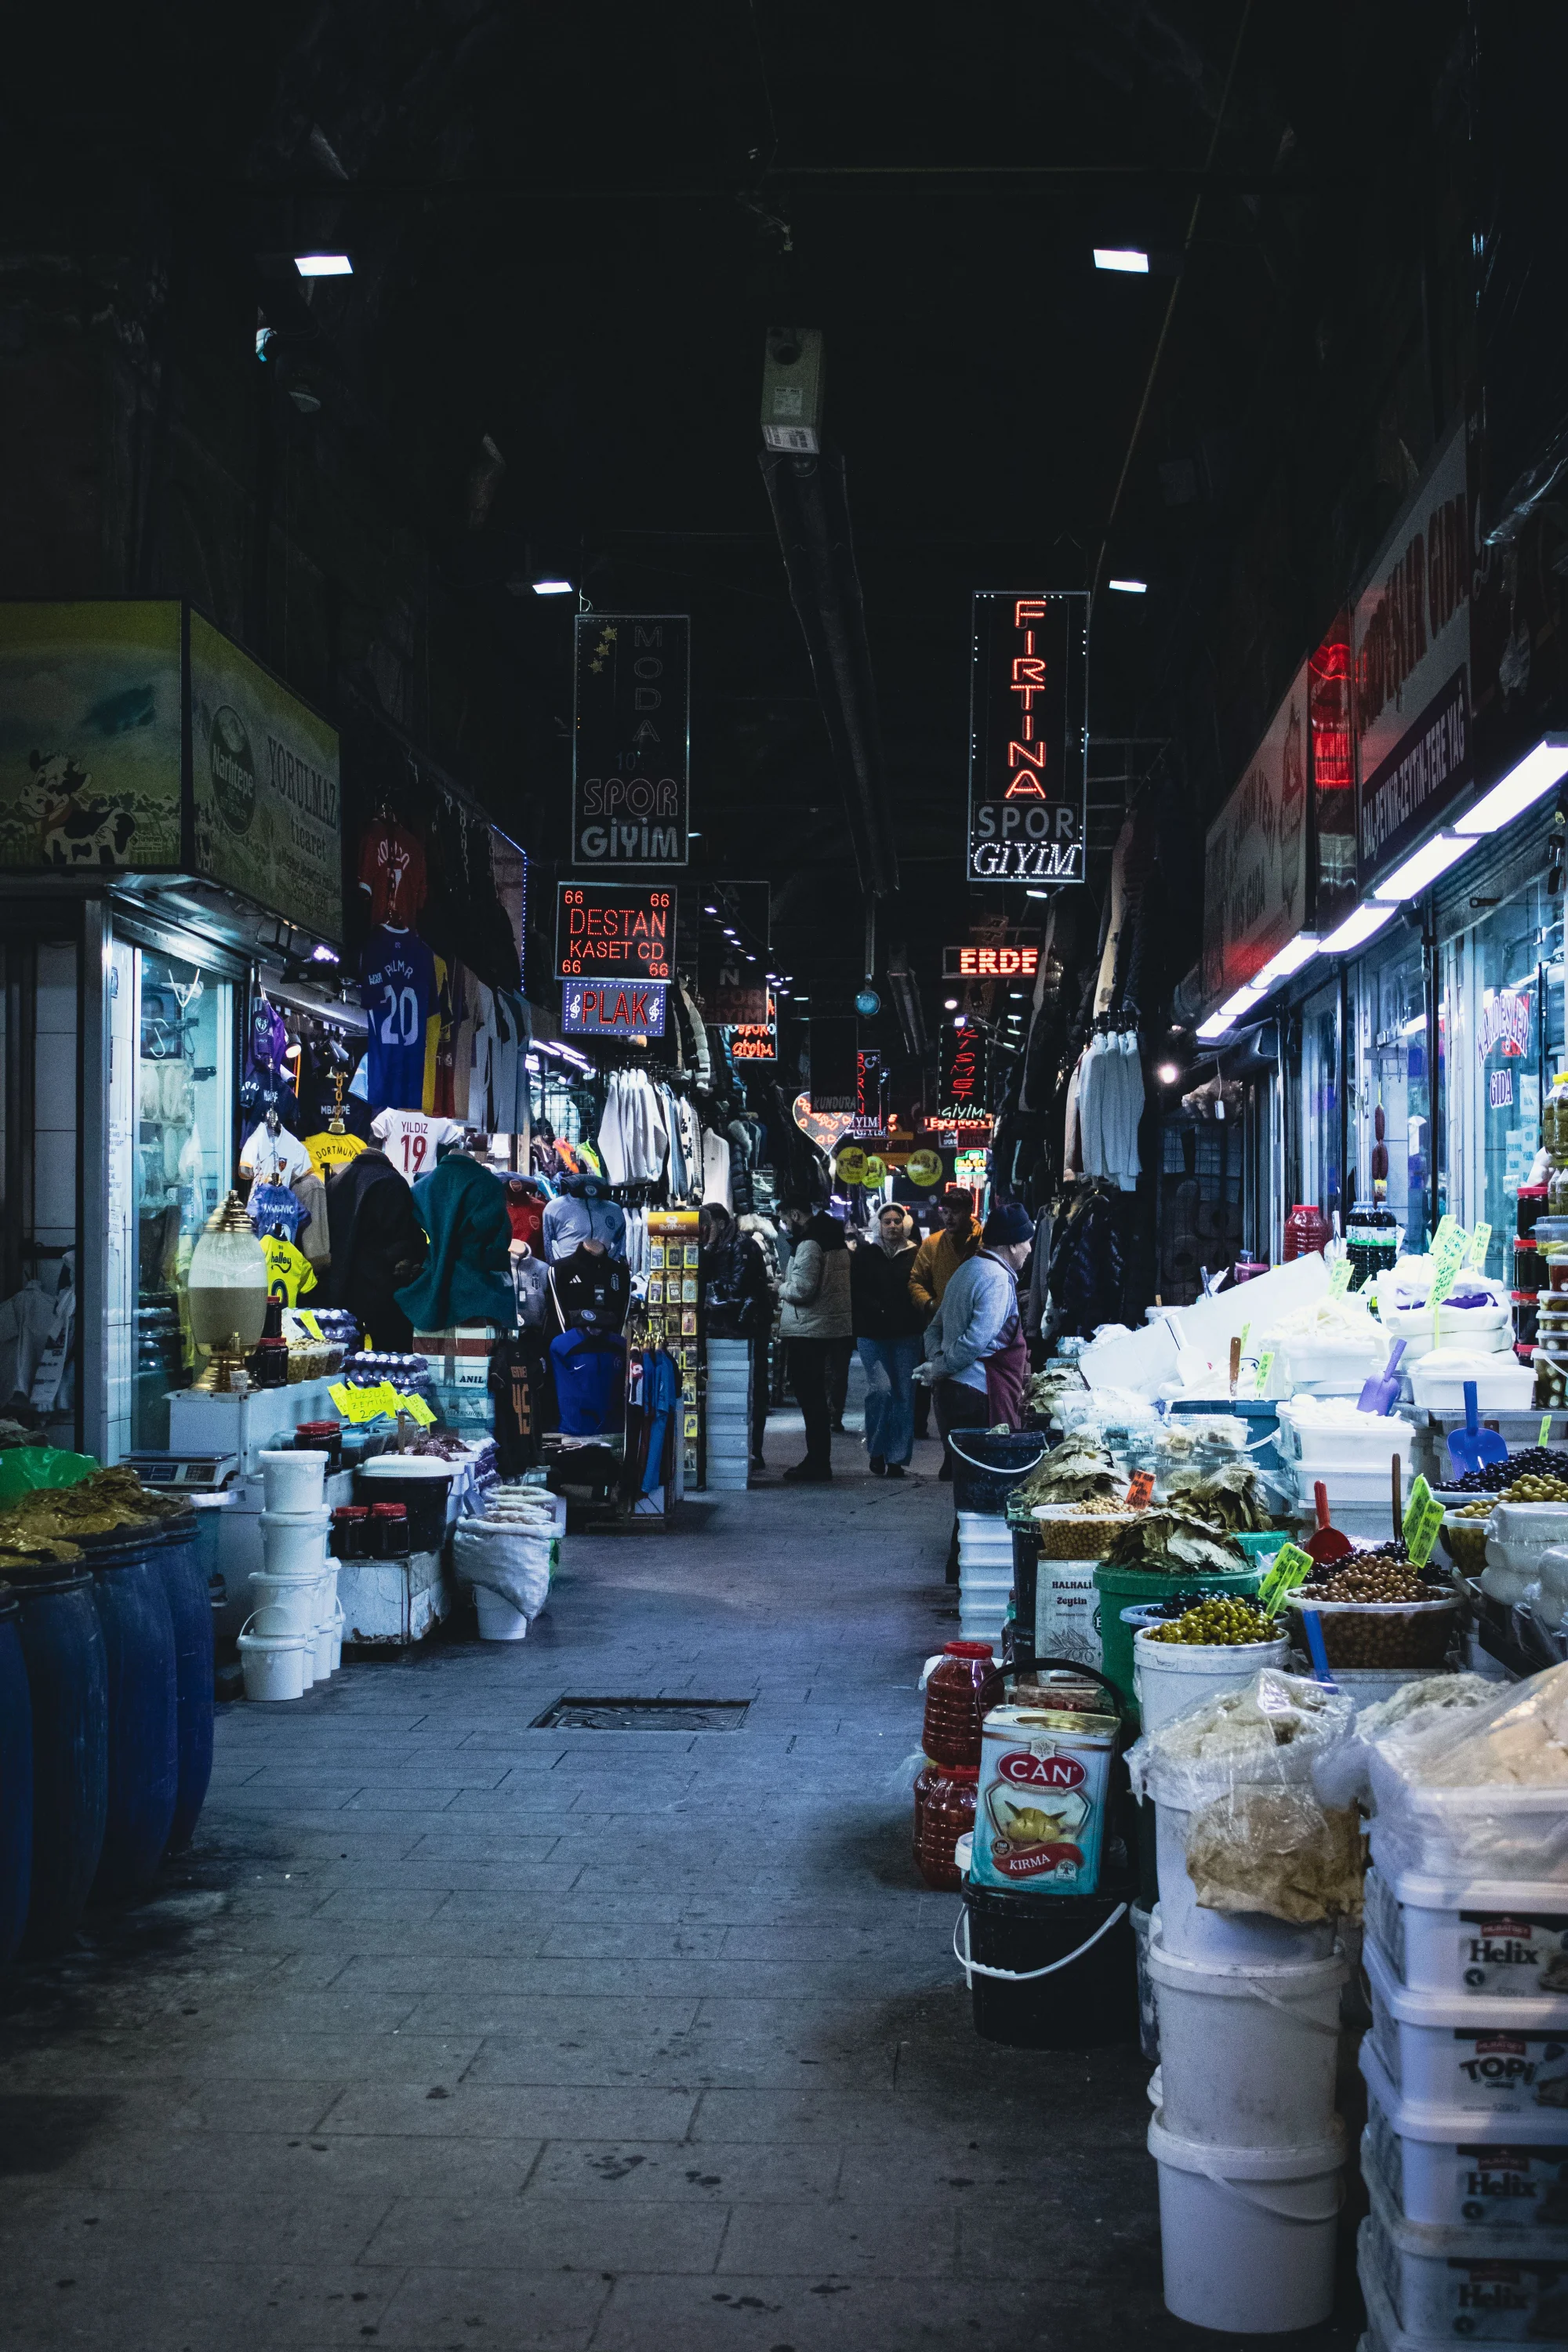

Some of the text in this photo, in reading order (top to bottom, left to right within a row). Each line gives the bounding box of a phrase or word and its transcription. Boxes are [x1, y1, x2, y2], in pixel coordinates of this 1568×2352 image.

[632, 626, 663, 742] MODA
[1004, 601, 1047, 799] FIRTINA
[267, 735, 336, 830] YORULMAZ
[584, 779, 678, 816] SPOR
[978, 806, 1074, 839] SPOR
[581, 818, 678, 858] GİYİM
[974, 841, 1081, 875] GİYİM
[564, 891, 583, 904] 66
[650, 894, 670, 907] 66
[570, 909, 666, 938] DESTAN
[570, 940, 664, 960] KASET CD
[960, 949, 1038, 974] ERDE
[384, 960, 413, 979] PLMR
[562, 960, 581, 973] 66
[649, 963, 669, 977] 66
[380, 985, 418, 1046] 20
[582, 990, 648, 1025] PLAK
[1477, 994, 1529, 1067] KARDEŞLER
[1490, 1069, 1512, 1108] GIDA
[321, 1104, 350, 1115] MBAPÉ
[813, 1096, 856, 1111] KUNDURA
[401, 1121, 429, 1134] YILDIZ
[401, 1134, 428, 1174] 19
[270, 1252, 292, 1265] halley
[459, 1375, 484, 1384] ANIL
[512, 1383, 531, 1435] 45
[1052, 1580, 1092, 1589] HALHALİ
[1057, 1596, 1087, 1607] Zeytin
[1010, 1760, 1072, 1784] CAN
[1010, 1853, 1051, 1871] KIRMA
[1469, 1939, 1538, 1965] Helix
[1467, 2172, 1537, 2198] Helix
[1458, 2284, 1528, 2310] Helix
